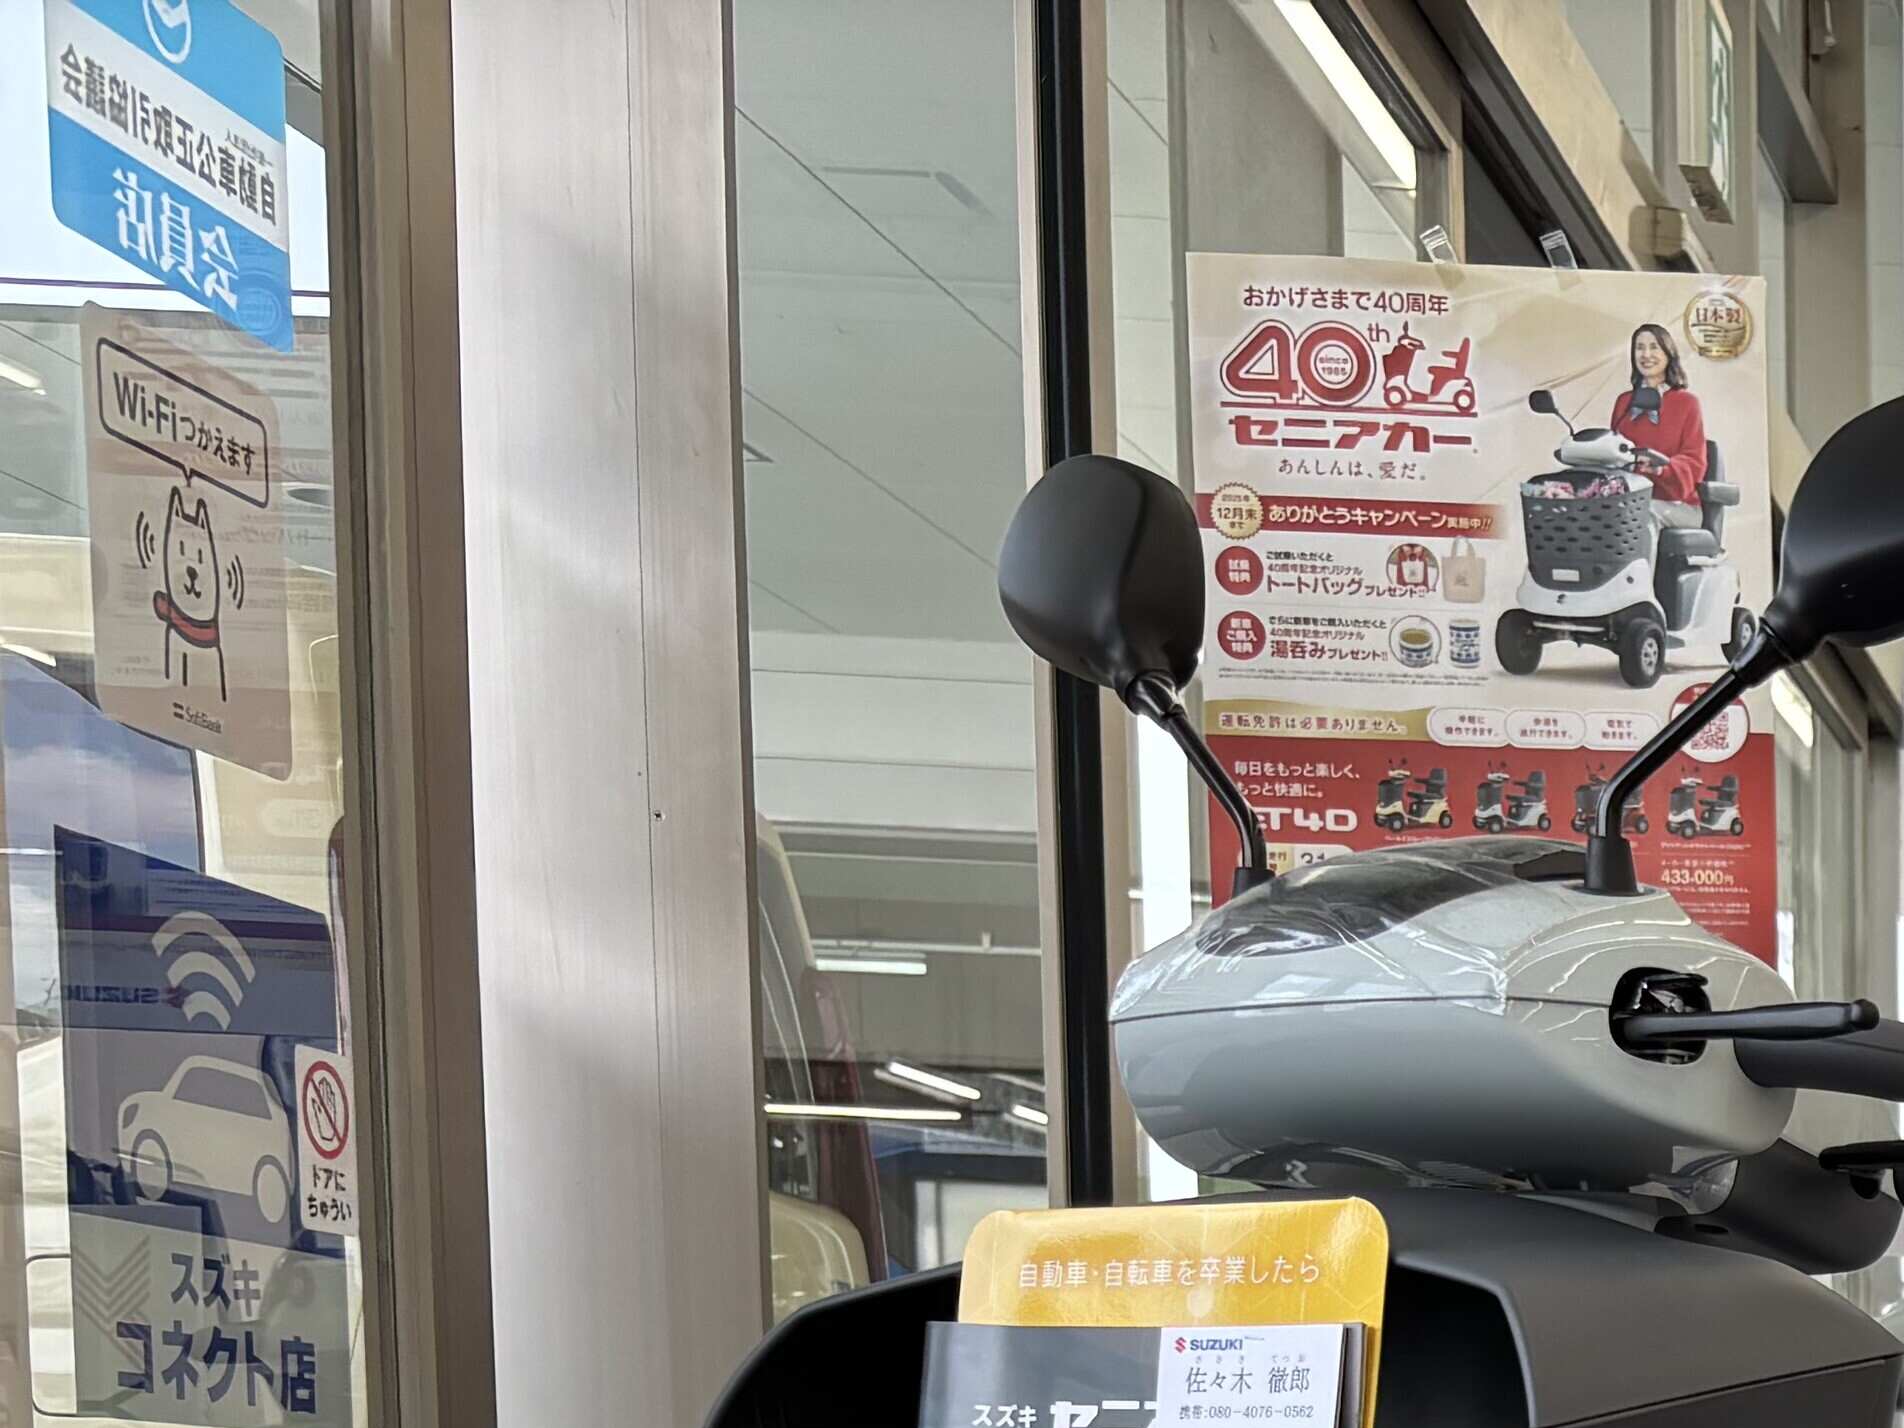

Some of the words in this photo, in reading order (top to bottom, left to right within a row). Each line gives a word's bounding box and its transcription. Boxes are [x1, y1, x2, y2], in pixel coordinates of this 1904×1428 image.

[1243, 285, 1449, 315] おかげさまで40周年
[1228, 415, 1472, 453] セニアカー
[1278, 459, 1426, 481] あんしんは、愛だ。
[1234, 760, 1360, 779] 毎日をもっと楽しく、
[312, 1165, 346, 1192] ドアに
[307, 1196, 353, 1222] ちゅうい
[171, 1253, 262, 1318] スズキ
[1018, 1254, 1321, 1289] 自動車・自転車を卒業したら
[1190, 1338, 1243, 1351] SUZUKI
[116, 1320, 316, 1415] コネクト店
[1185, 1366, 1253, 1395] 佐々木
[971, 1404, 1038, 1428] スズキ
